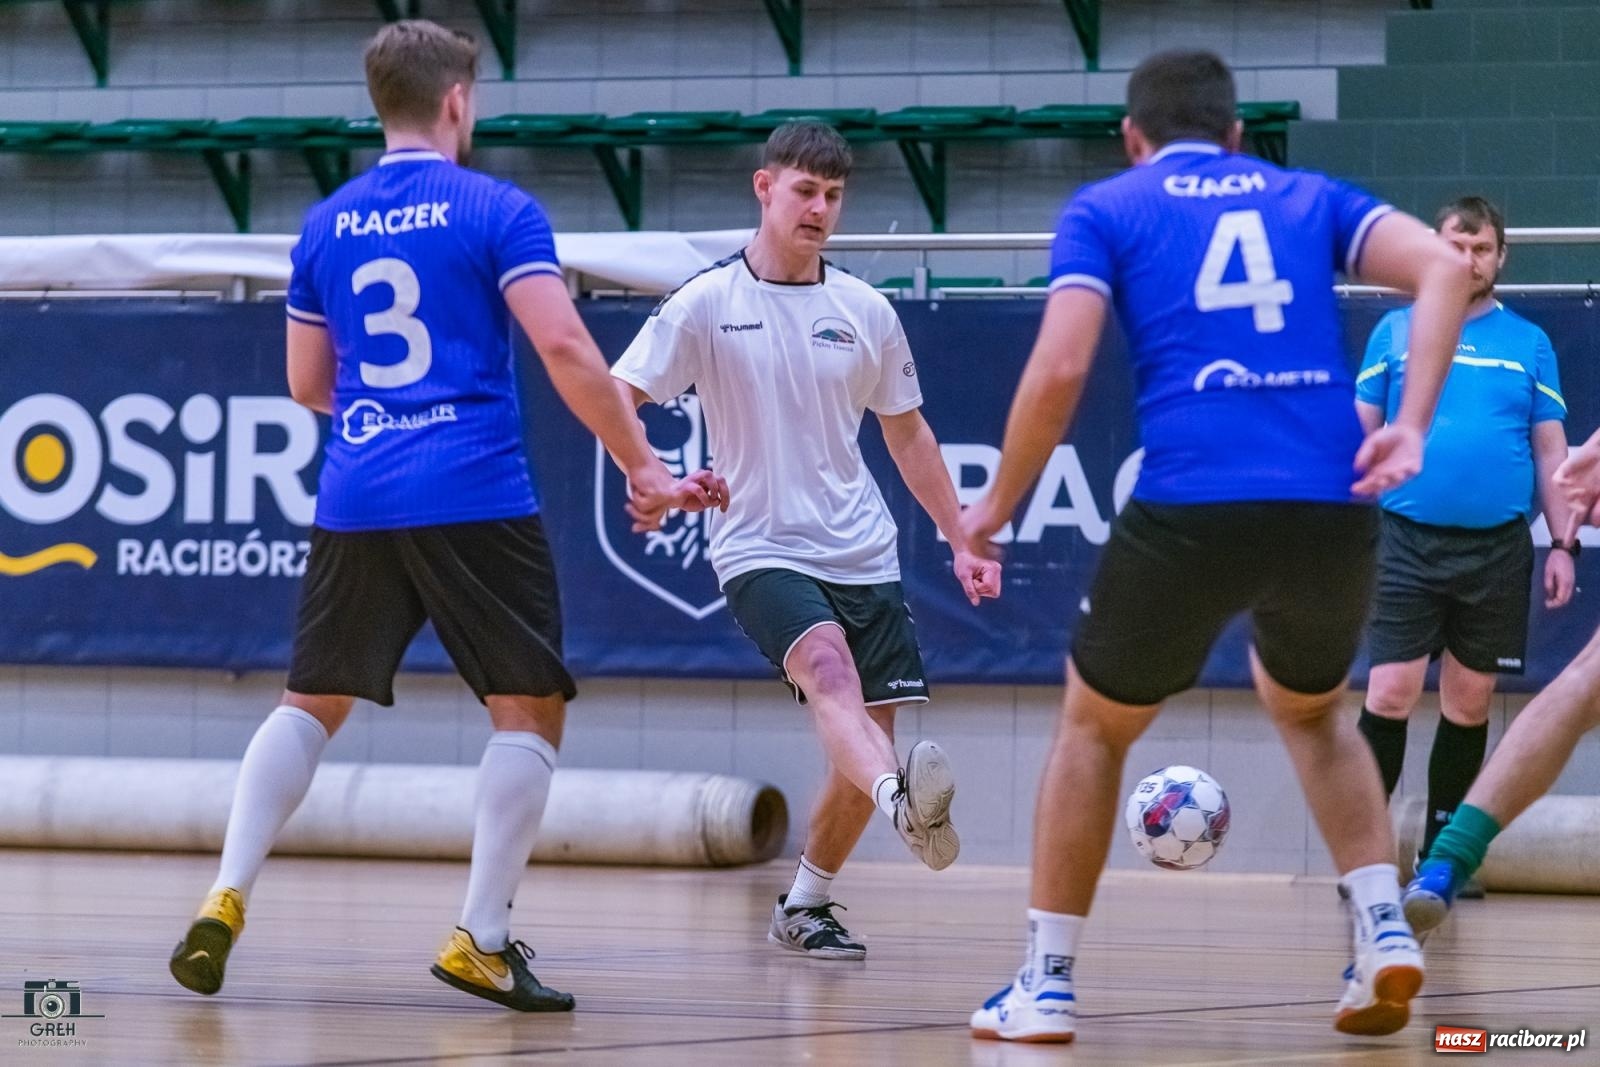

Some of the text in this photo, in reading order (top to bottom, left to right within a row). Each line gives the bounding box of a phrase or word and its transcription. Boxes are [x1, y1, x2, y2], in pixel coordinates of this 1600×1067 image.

[335, 202, 450, 238] PŁACZEK
[1194, 209, 1294, 333] 4
[351, 257, 432, 388] 3
[730, 320, 763, 332] hummel
[0, 393, 318, 526] OSiR
